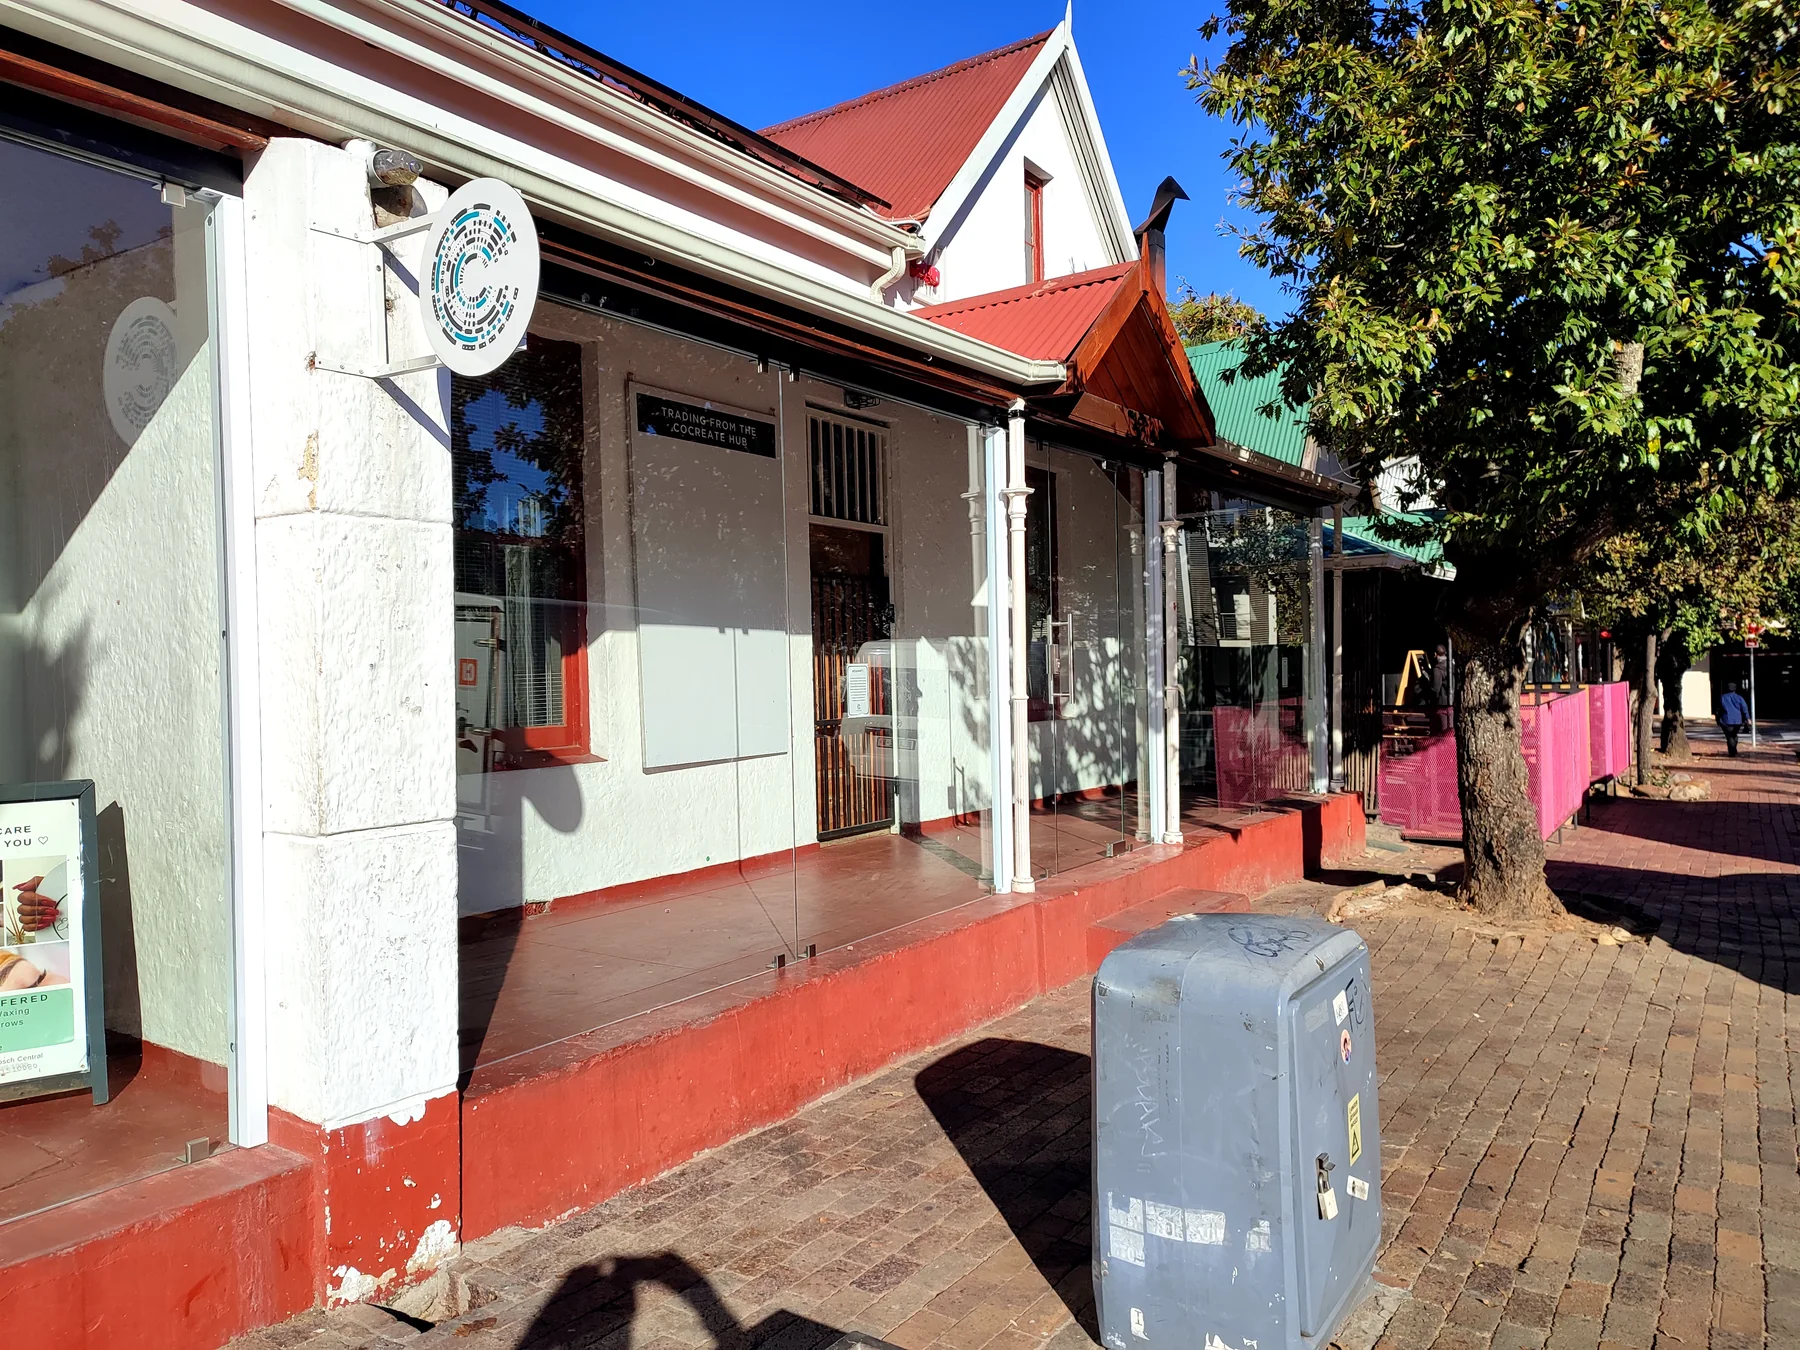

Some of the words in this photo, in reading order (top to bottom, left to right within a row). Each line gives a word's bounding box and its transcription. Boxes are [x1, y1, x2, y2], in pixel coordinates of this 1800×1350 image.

[661, 407, 706, 425] TRADING
[710, 418, 736, 432] FROM
[739, 424, 757, 437] THE
[672, 422, 725, 442] COCREATE
[729, 435, 748, 447] HUB
[4, 838, 31, 847] YOU
[0, 994, 48, 1007] FERED
[17, 1052, 44, 1062] Central
